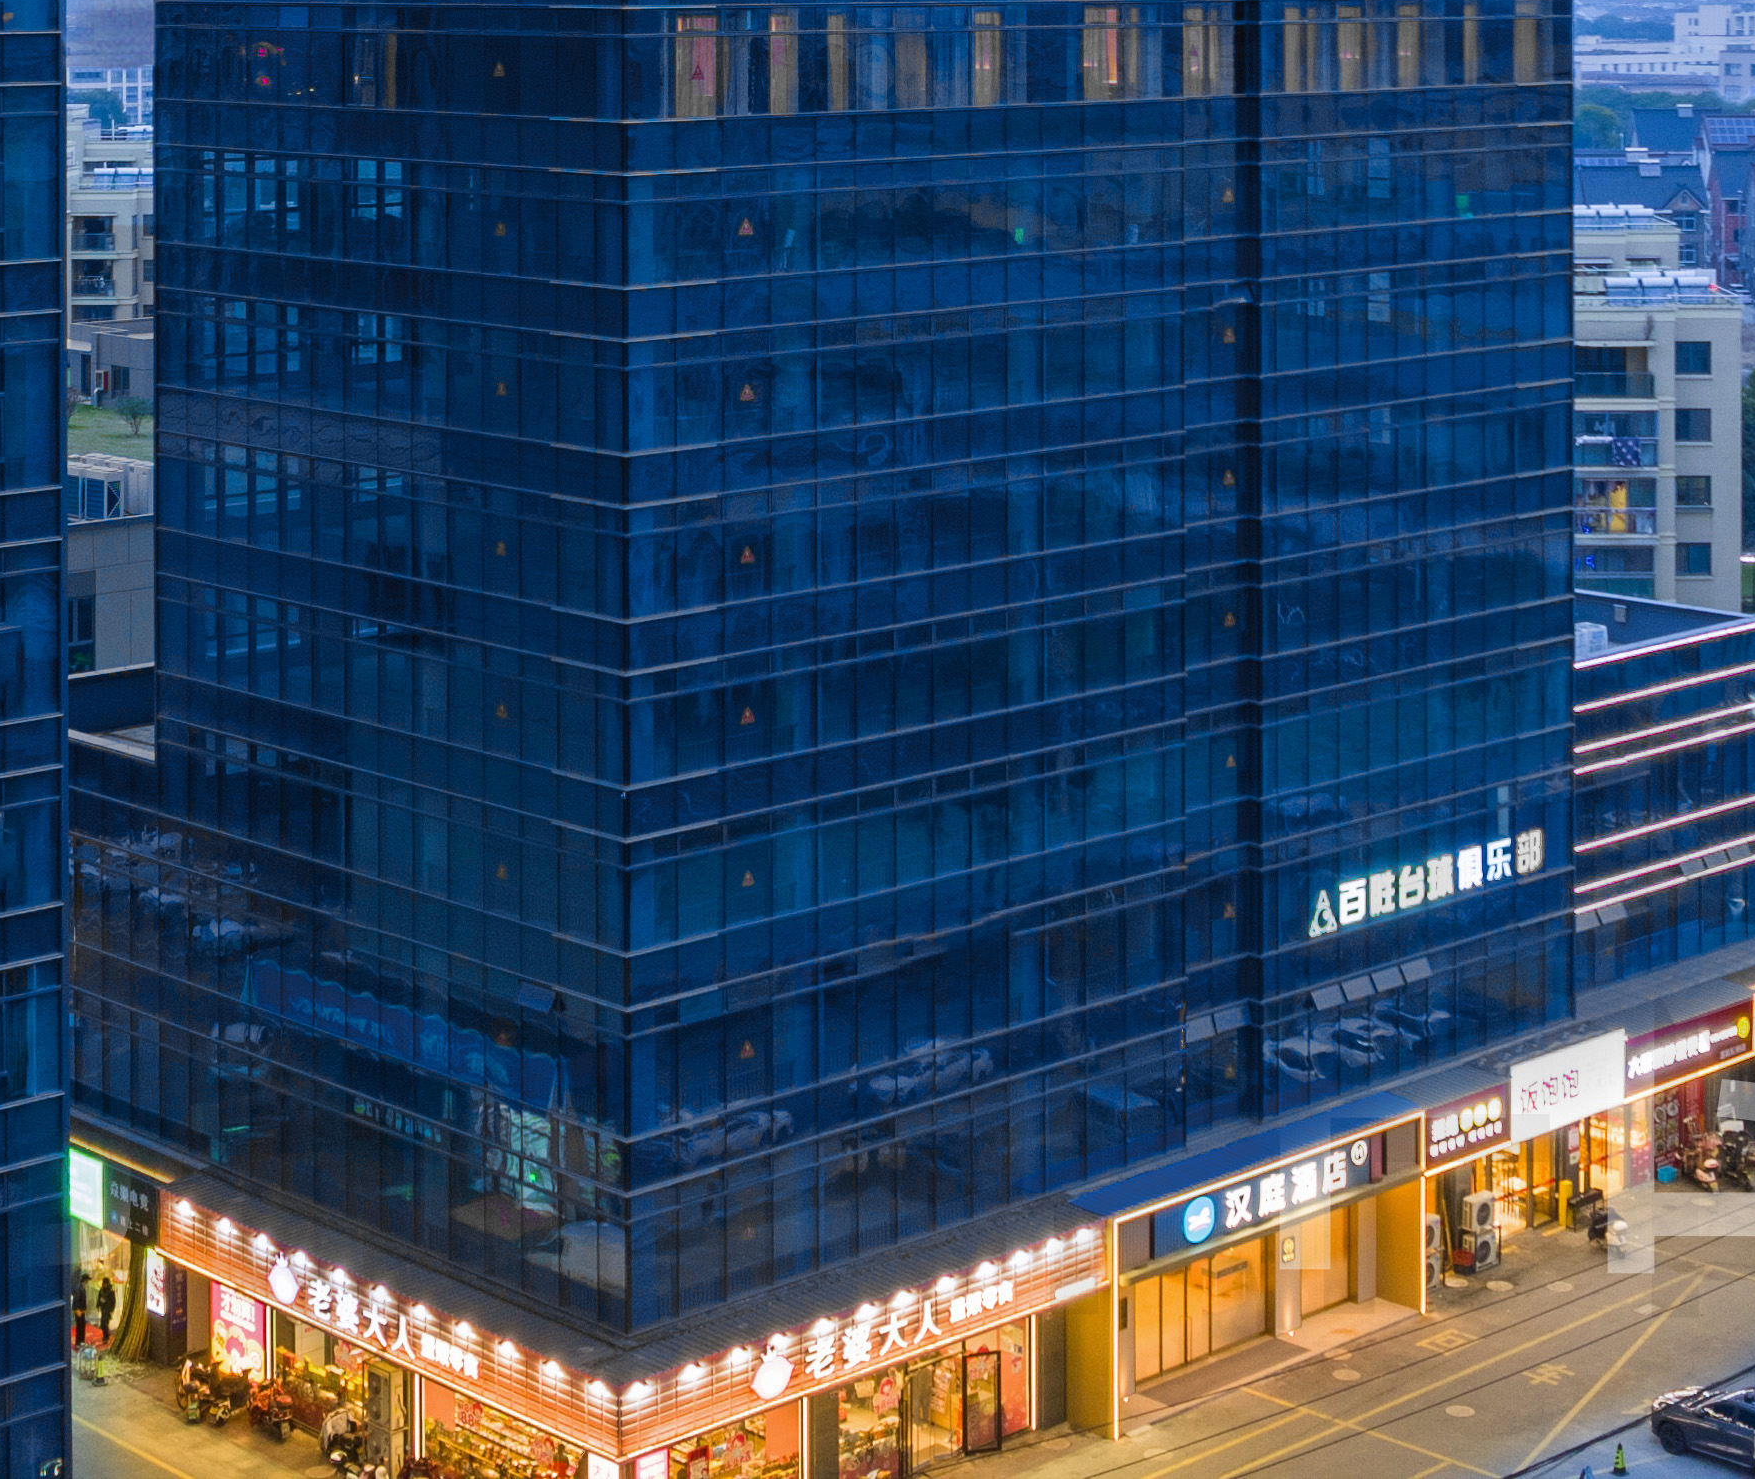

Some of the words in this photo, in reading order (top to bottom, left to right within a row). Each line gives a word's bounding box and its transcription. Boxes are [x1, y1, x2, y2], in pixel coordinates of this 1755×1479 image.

[1338, 827, 1543, 926] 百胜台球俱乐部
[1225, 1150, 1347, 1229] 汉庭酒店
[308, 1279, 415, 1360] 老婆大人
[805, 1301, 942, 1379] 老婆大人
